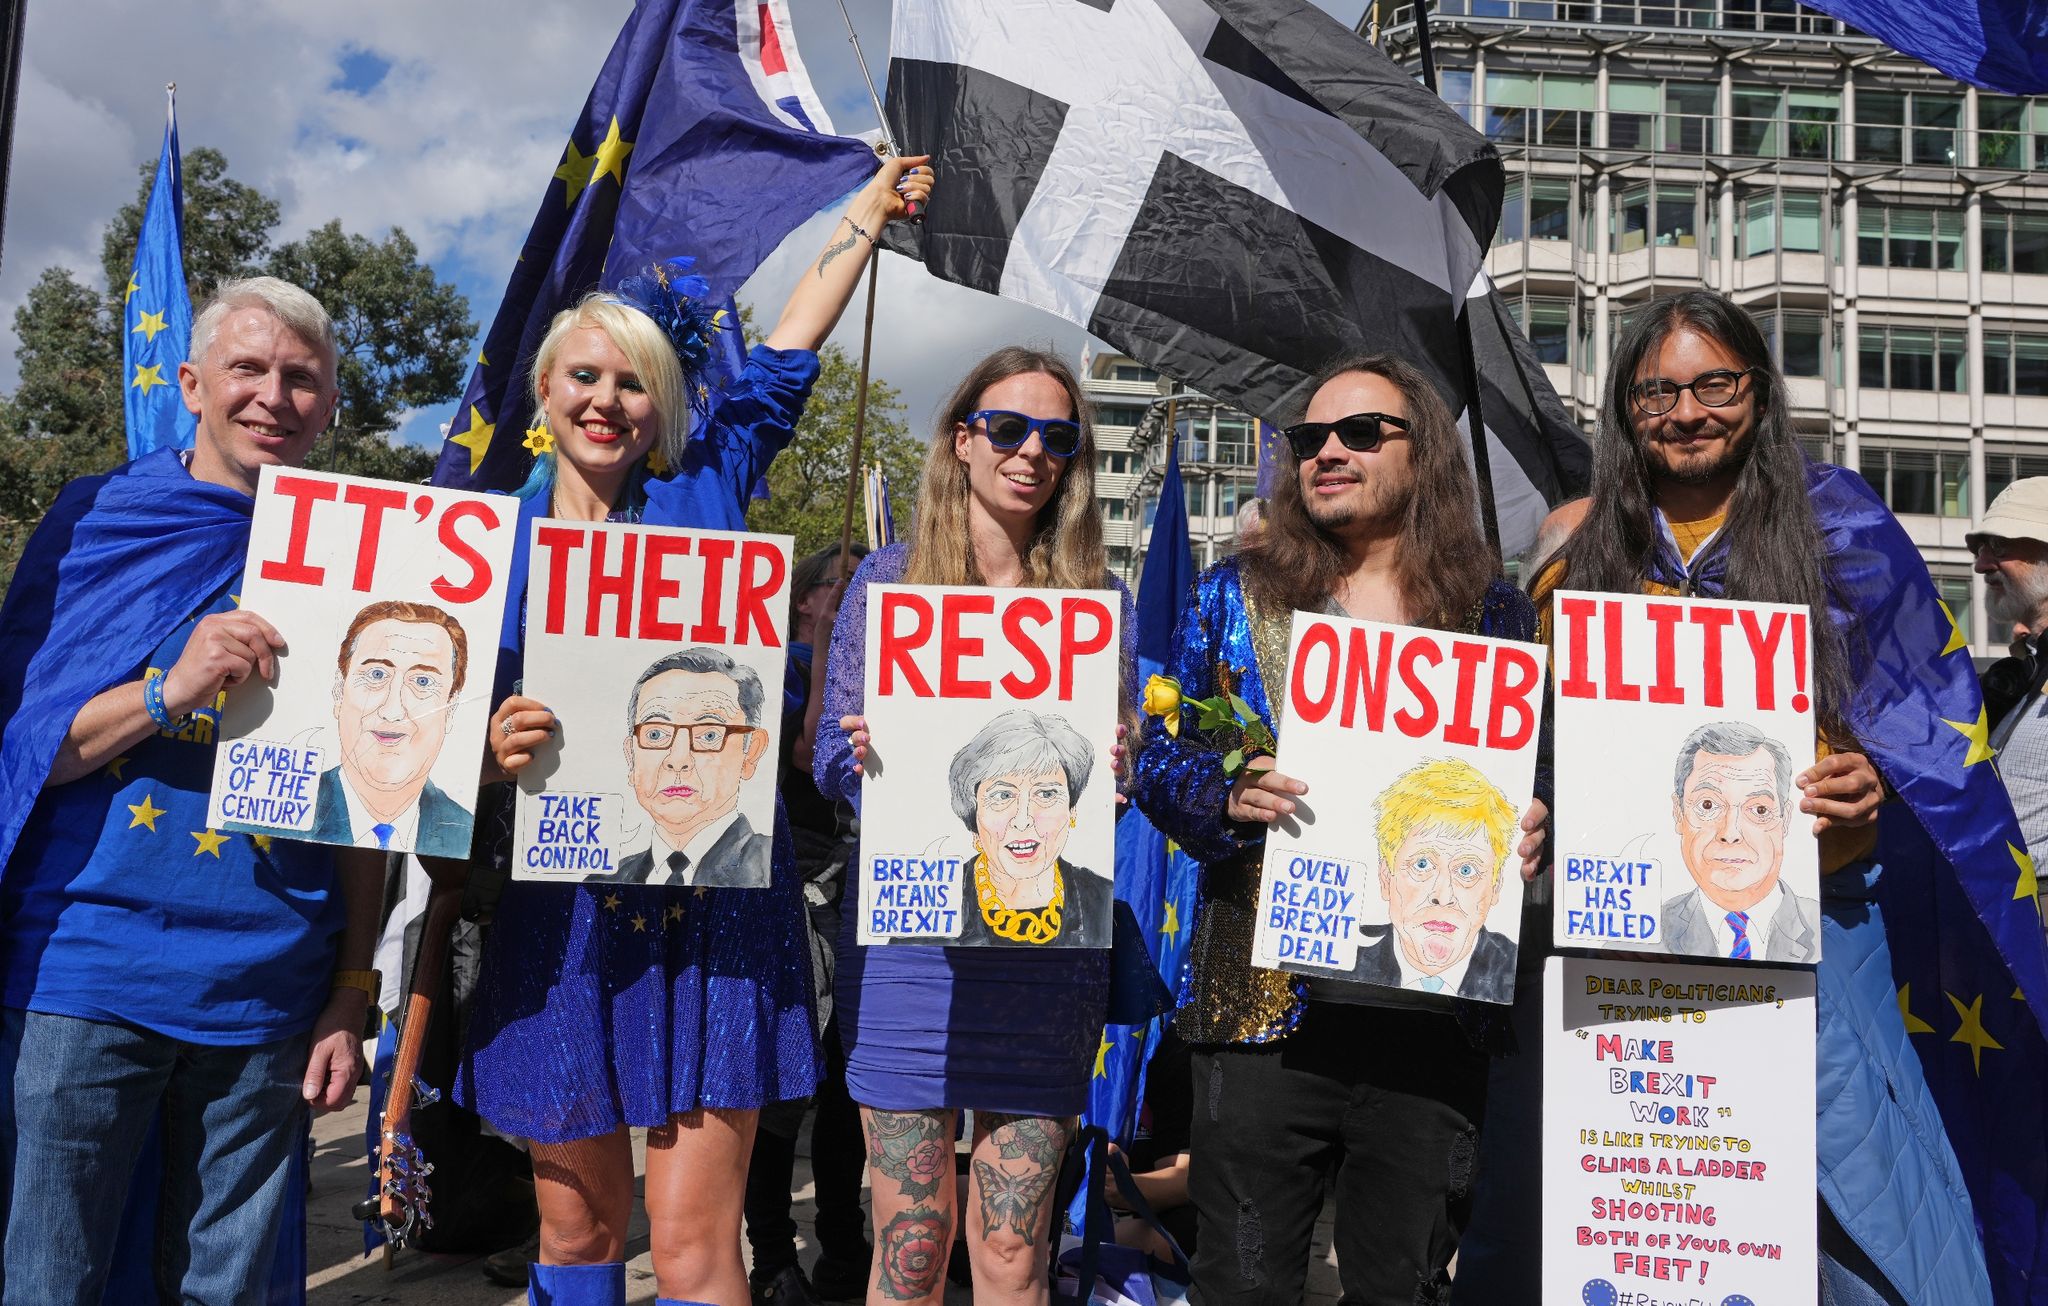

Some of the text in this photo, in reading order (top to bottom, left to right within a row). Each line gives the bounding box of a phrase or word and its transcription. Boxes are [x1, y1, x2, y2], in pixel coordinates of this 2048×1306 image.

[261, 476, 500, 604] IT’S
[538, 527, 785, 648] THEIR
[878, 592, 1113, 701] RESP
[1561, 598, 1809, 713] ILITY!
[1291, 623, 1539, 750] ONSIB
[230, 743, 317, 775] GAMBLE
[229, 767, 309, 800] OF THE
[223, 794, 310, 824] CENTURY
[539, 796, 601, 819] TAKE
[539, 819, 600, 844] BACK
[527, 846, 613, 870] CONTROL
[874, 859, 959, 881] BREXIT
[1289, 858, 1348, 886] OVEN
[1568, 859, 1652, 885] BREXIT
[877, 885, 948, 908] MEANS
[1273, 881, 1352, 912] READY
[1586, 888, 1631, 911] HAS
[872, 910, 957, 933] BREXIT
[1270, 906, 1355, 938] BREXIT
[1568, 911, 1655, 939] FAILED
[1279, 934, 1338, 964] DEAL
[1586, 975, 1784, 1008] DEAR POLITICIANS,
[1598, 1004, 1707, 1024] TRYING TO
[1610, 1068, 1716, 1098] BREXIT
[1581, 1129, 1751, 1152] IS LIKE TRYING TO
[1581, 1155, 1766, 1181] CLIMB A LADDER
[1623, 1180, 1695, 1199] WHILST
[1592, 1197, 1716, 1226] SHOOTING
[1577, 1227, 1781, 1259] BOTH OF YOUR OWN
[1614, 1253, 1709, 1285] FEET!
